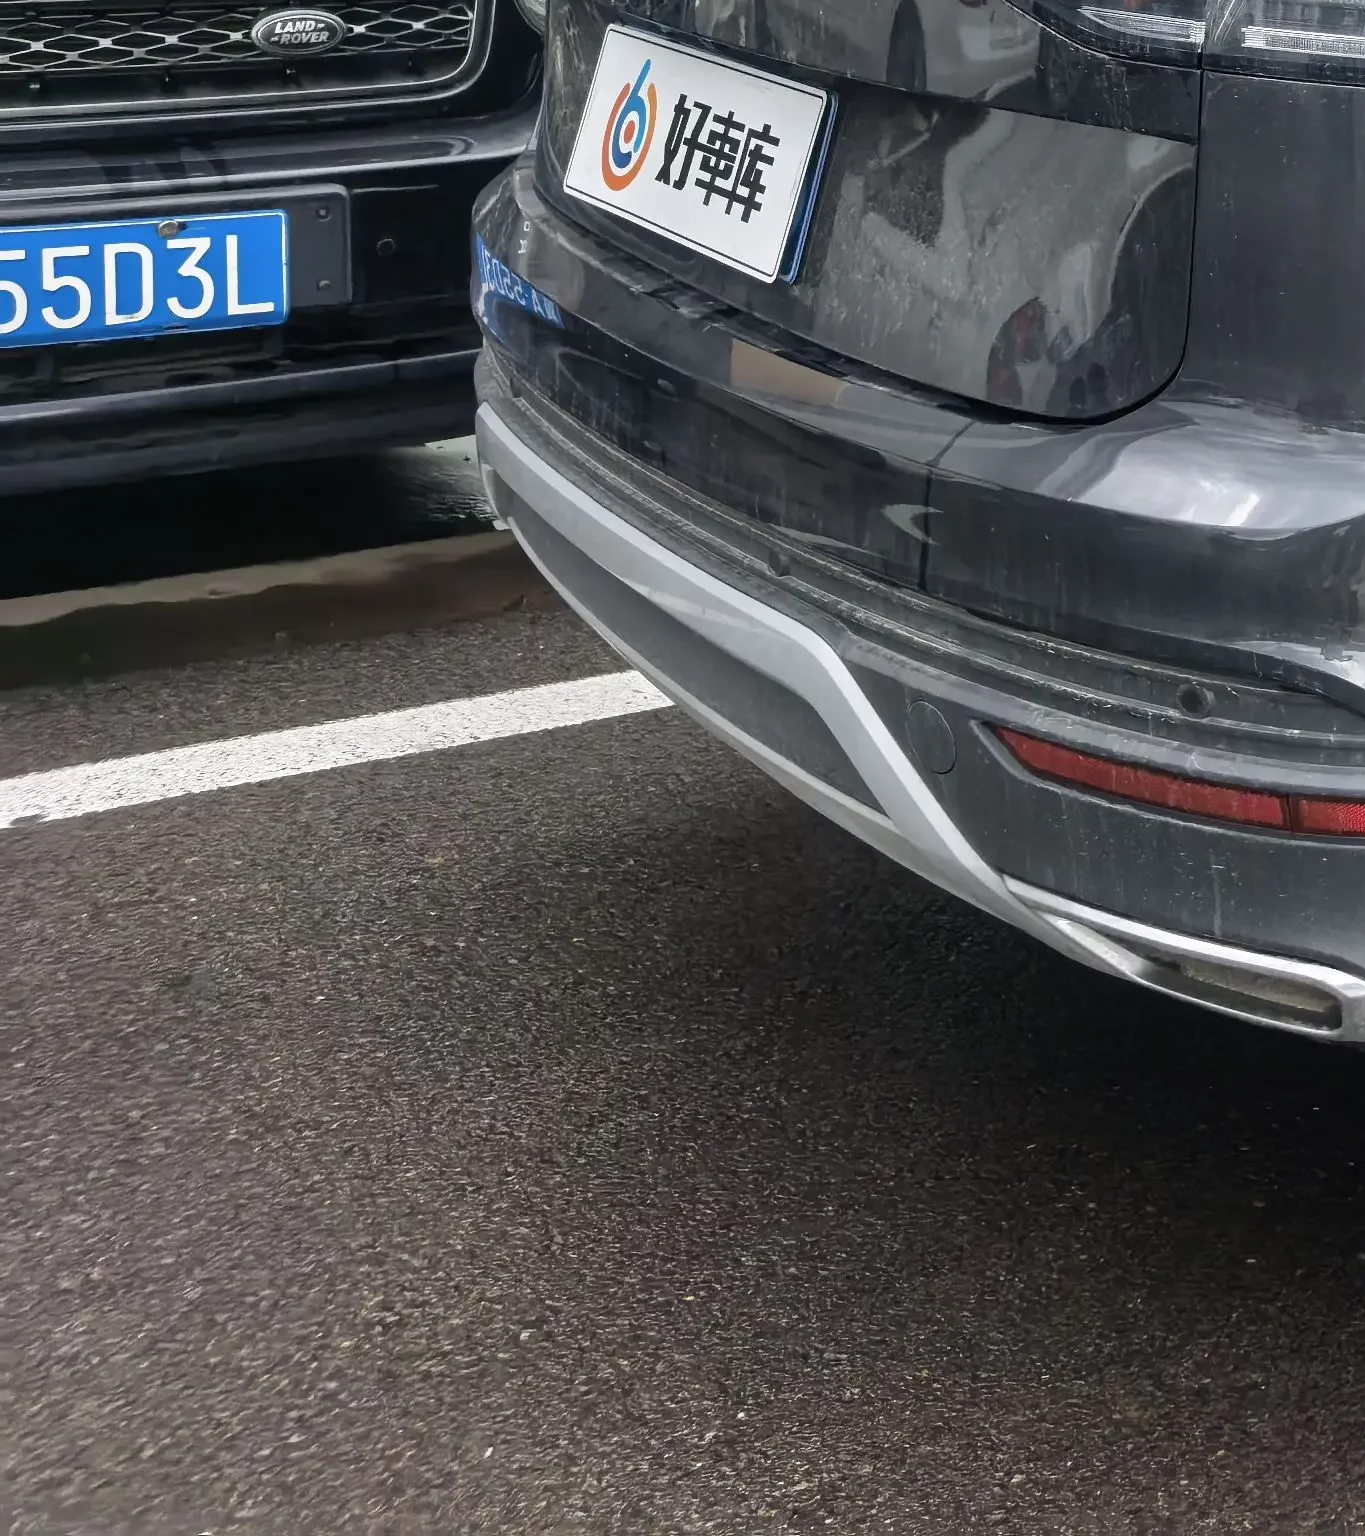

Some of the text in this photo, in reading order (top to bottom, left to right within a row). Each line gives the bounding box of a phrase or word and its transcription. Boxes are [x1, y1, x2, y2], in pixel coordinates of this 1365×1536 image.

[274, 20, 316, 34] LAND
[279, 31, 330, 45] ROVER
[654, 93, 781, 224] 好車库
